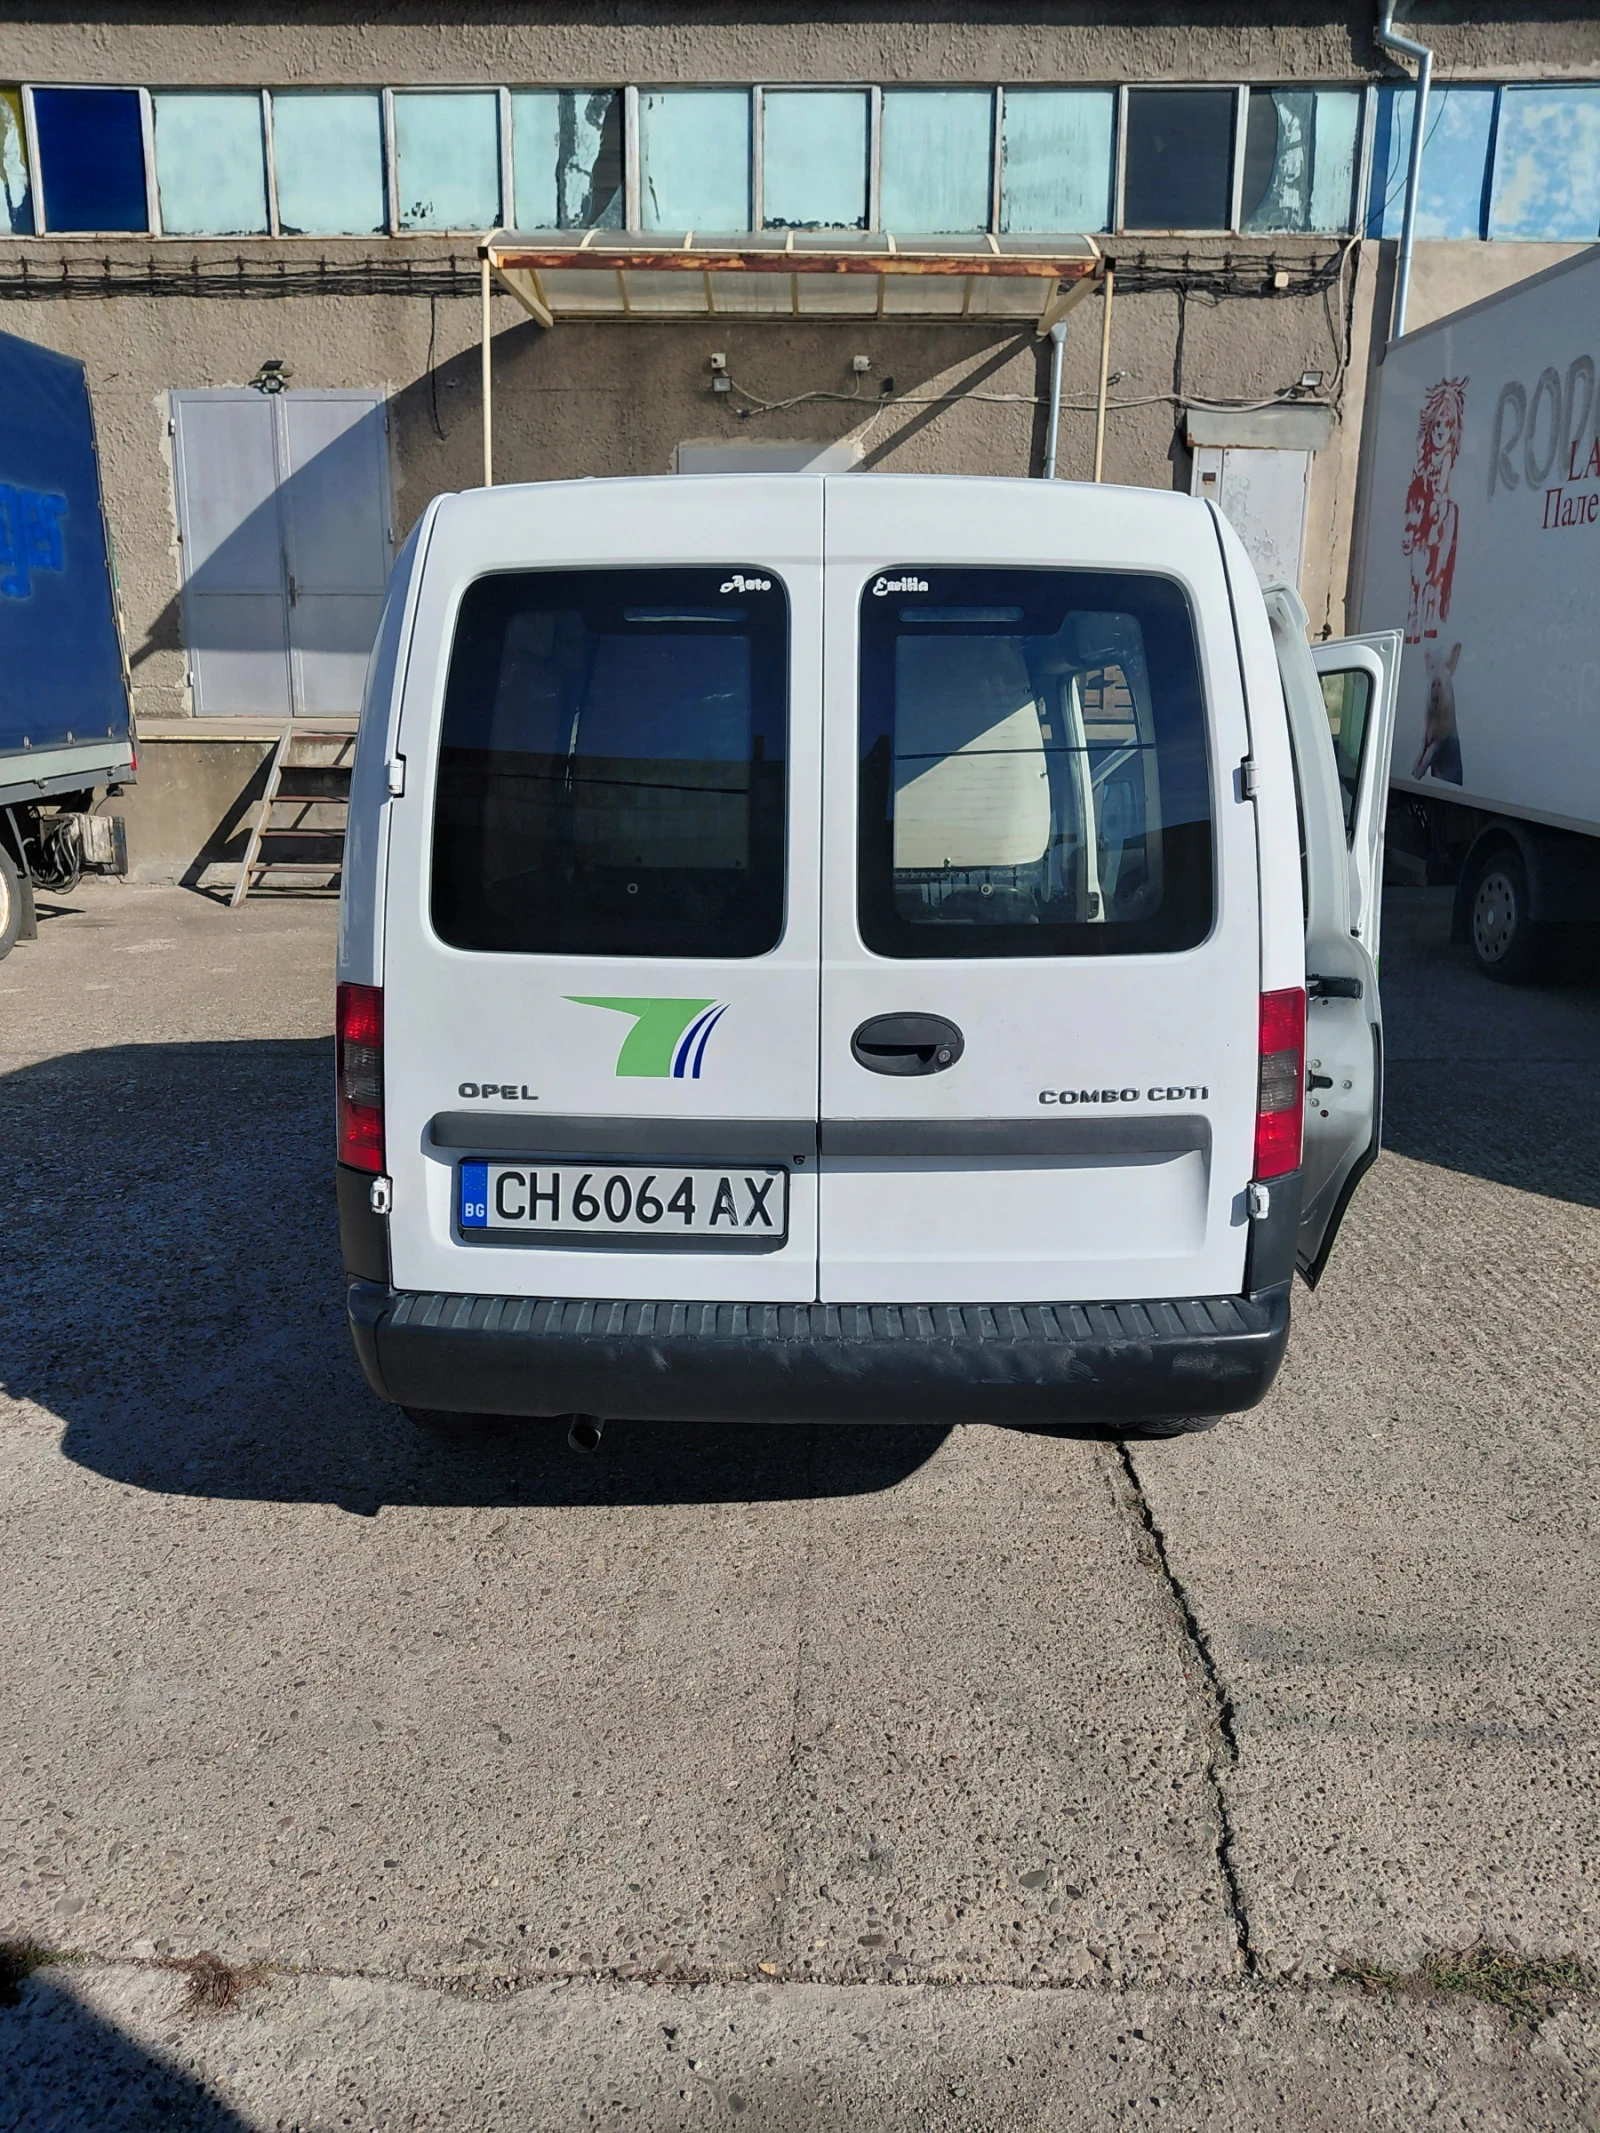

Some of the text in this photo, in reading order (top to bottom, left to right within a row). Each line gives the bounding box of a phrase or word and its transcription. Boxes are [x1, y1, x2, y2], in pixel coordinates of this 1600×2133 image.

[720, 574, 929, 597] Auto Emilia
[458, 1082, 539, 1101] OPEL
[1038, 1087, 1141, 1105] COMBO
[464, 1202, 486, 1219] BG
